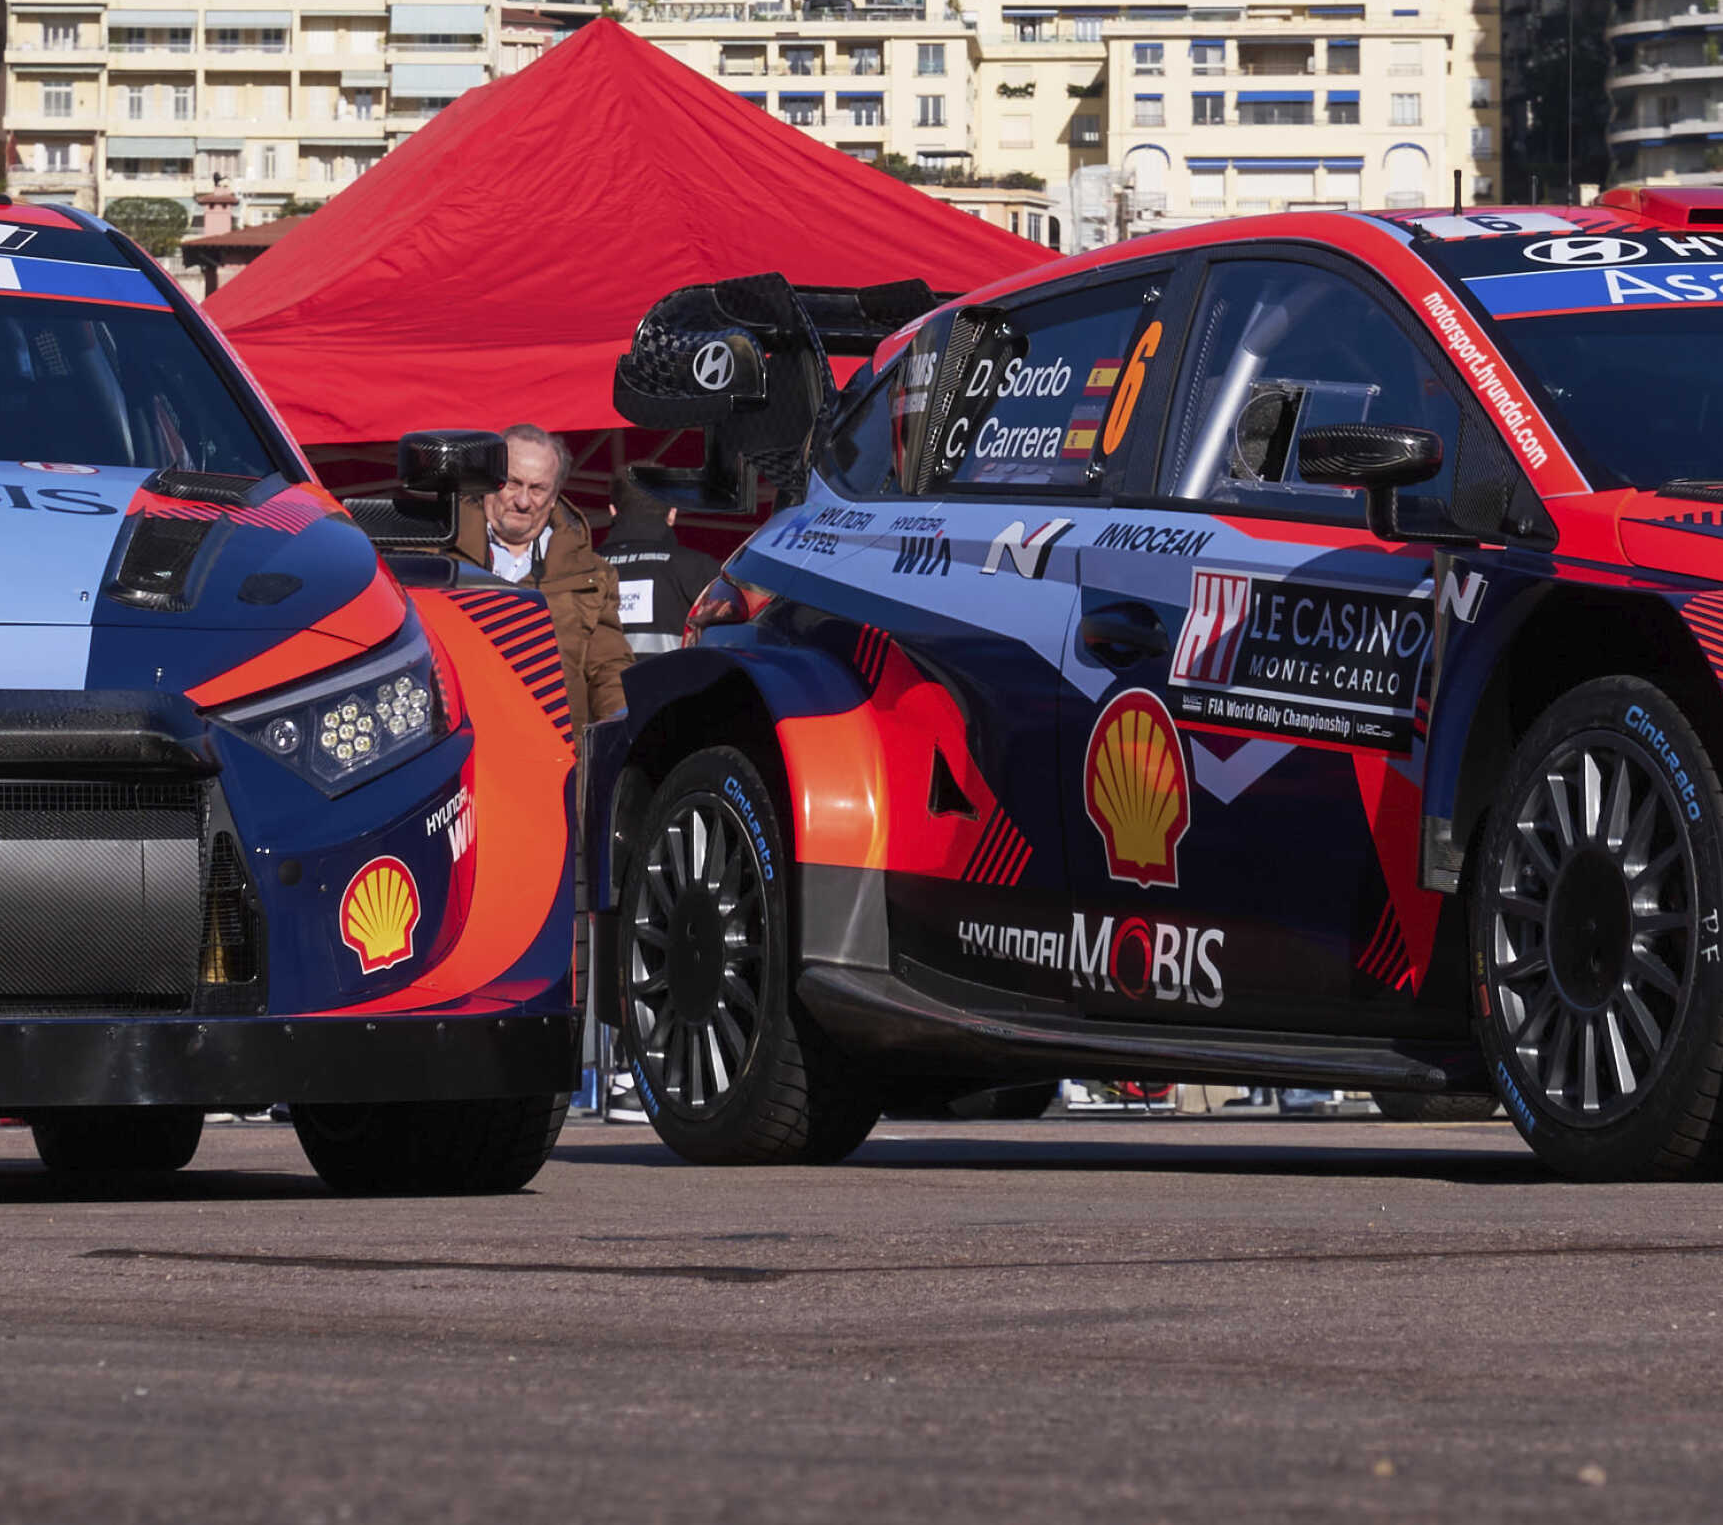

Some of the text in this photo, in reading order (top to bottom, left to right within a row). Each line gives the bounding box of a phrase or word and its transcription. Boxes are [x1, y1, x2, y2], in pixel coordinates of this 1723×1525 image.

[1465, 216, 1523, 231] 6
[966, 359, 992, 397] D.
[997, 357, 1072, 397] Sordo
[1102, 320, 1163, 456] 6
[1422, 292, 1548, 469] motorsport.hyundai.com
[945, 417, 1062, 458] C. Carrera
[814, 507, 876, 531] HYUNDAI
[890, 516, 946, 532] HYUNDAI
[1093, 522, 1217, 557] INNOCEAN
[797, 530, 840, 556] STEEL
[892, 530, 951, 577] WIA
[1248, 593, 1285, 642] LE
[1292, 597, 1427, 658] CASINO
[1208, 698, 1224, 715] FIA
[1227, 702, 1254, 721] World
[1256, 706, 1281, 727] Rally
[1283, 709, 1350, 738] Championship
[1624, 705, 1701, 821] Cinturato
[724, 776, 774, 880] Cinturato
[958, 912, 1225, 1009] HYUNDAI MOBIS
